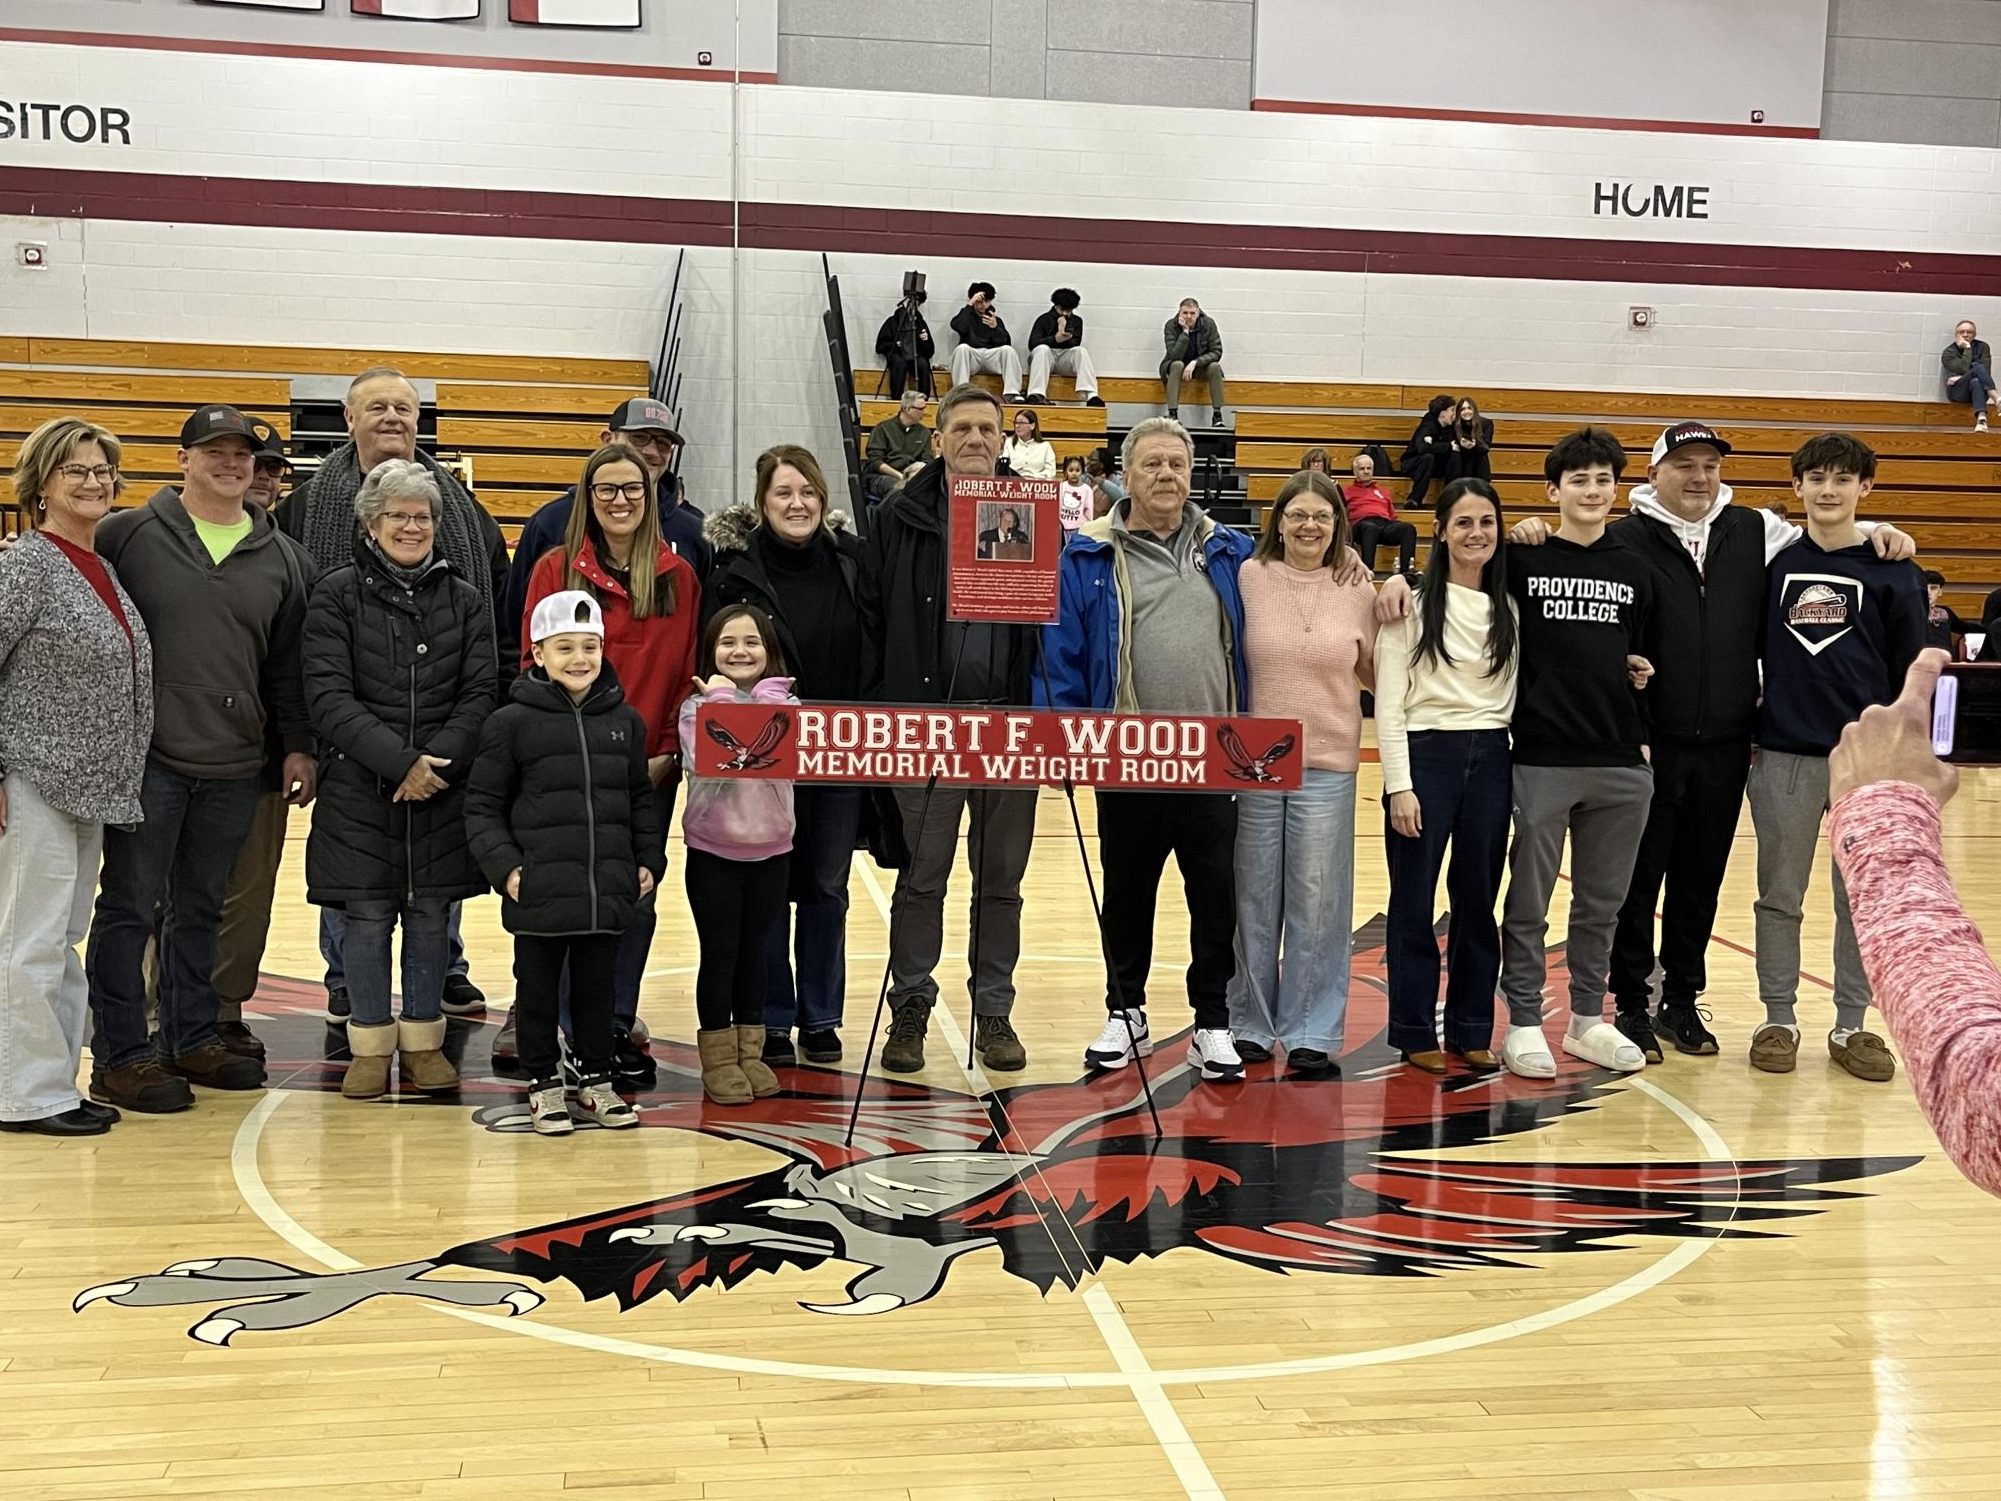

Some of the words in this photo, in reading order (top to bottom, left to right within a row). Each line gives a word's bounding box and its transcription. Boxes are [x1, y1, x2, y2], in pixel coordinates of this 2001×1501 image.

[1594, 182, 1709, 219] HOME
[954, 489, 997, 498] MEMORIAL
[1000, 491, 1032, 499] WEIGHT
[1527, 577, 1634, 604] PROVIDENCE
[1543, 599, 1620, 623] COLLEGE
[1789, 606, 1847, 618] BACKYARD
[796, 709, 991, 752] ROBERT
[1004, 715, 1044, 754] F.
[1059, 717, 1208, 758] WOOD
[797, 751, 970, 778] MEMORIAL
[982, 755, 1110, 781] WEIGHT
[1120, 758, 1206, 783] ROOM
